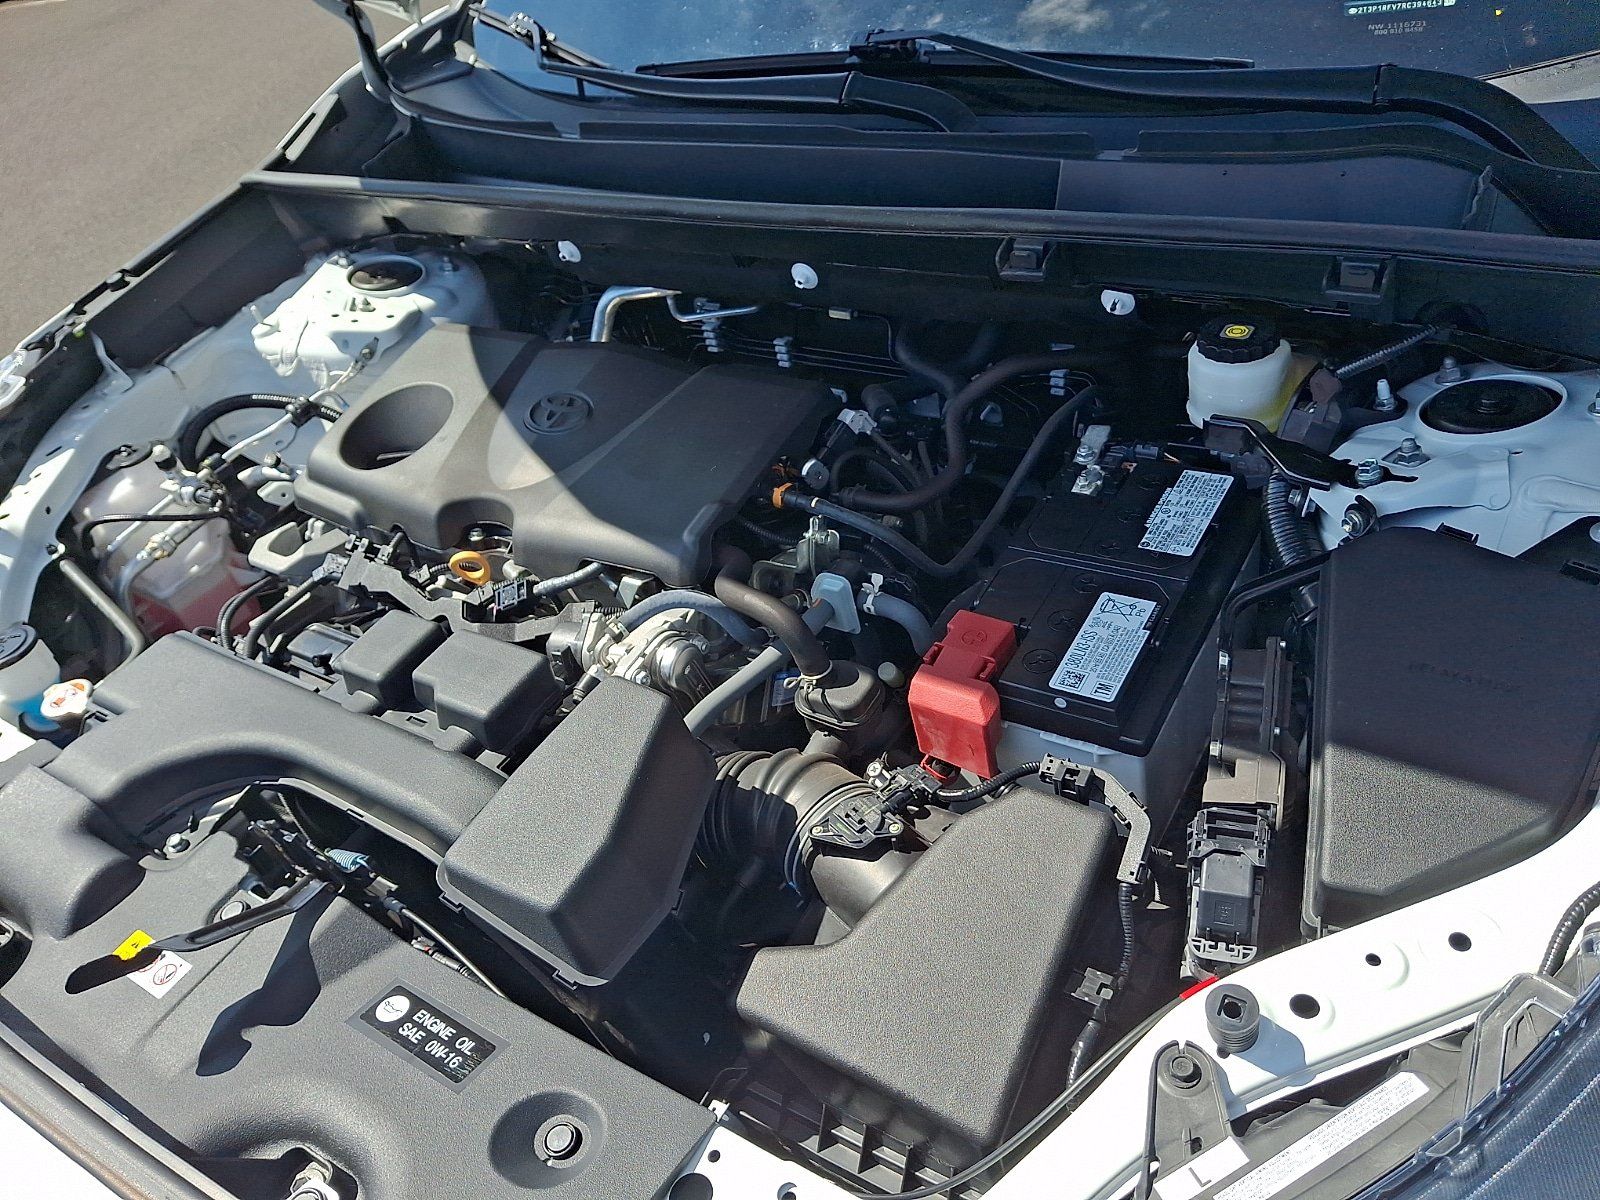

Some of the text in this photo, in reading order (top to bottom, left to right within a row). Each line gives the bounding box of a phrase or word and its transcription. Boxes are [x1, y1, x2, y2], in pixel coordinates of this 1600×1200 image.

[1135, 608, 1147, 618] Pb
[1094, 682, 1115, 696] TM
[412, 1009, 476, 1056] ENGINE OIL
[398, 1022, 462, 1069] SAE 0W-16
[1188, 1166, 1212, 1188] L
